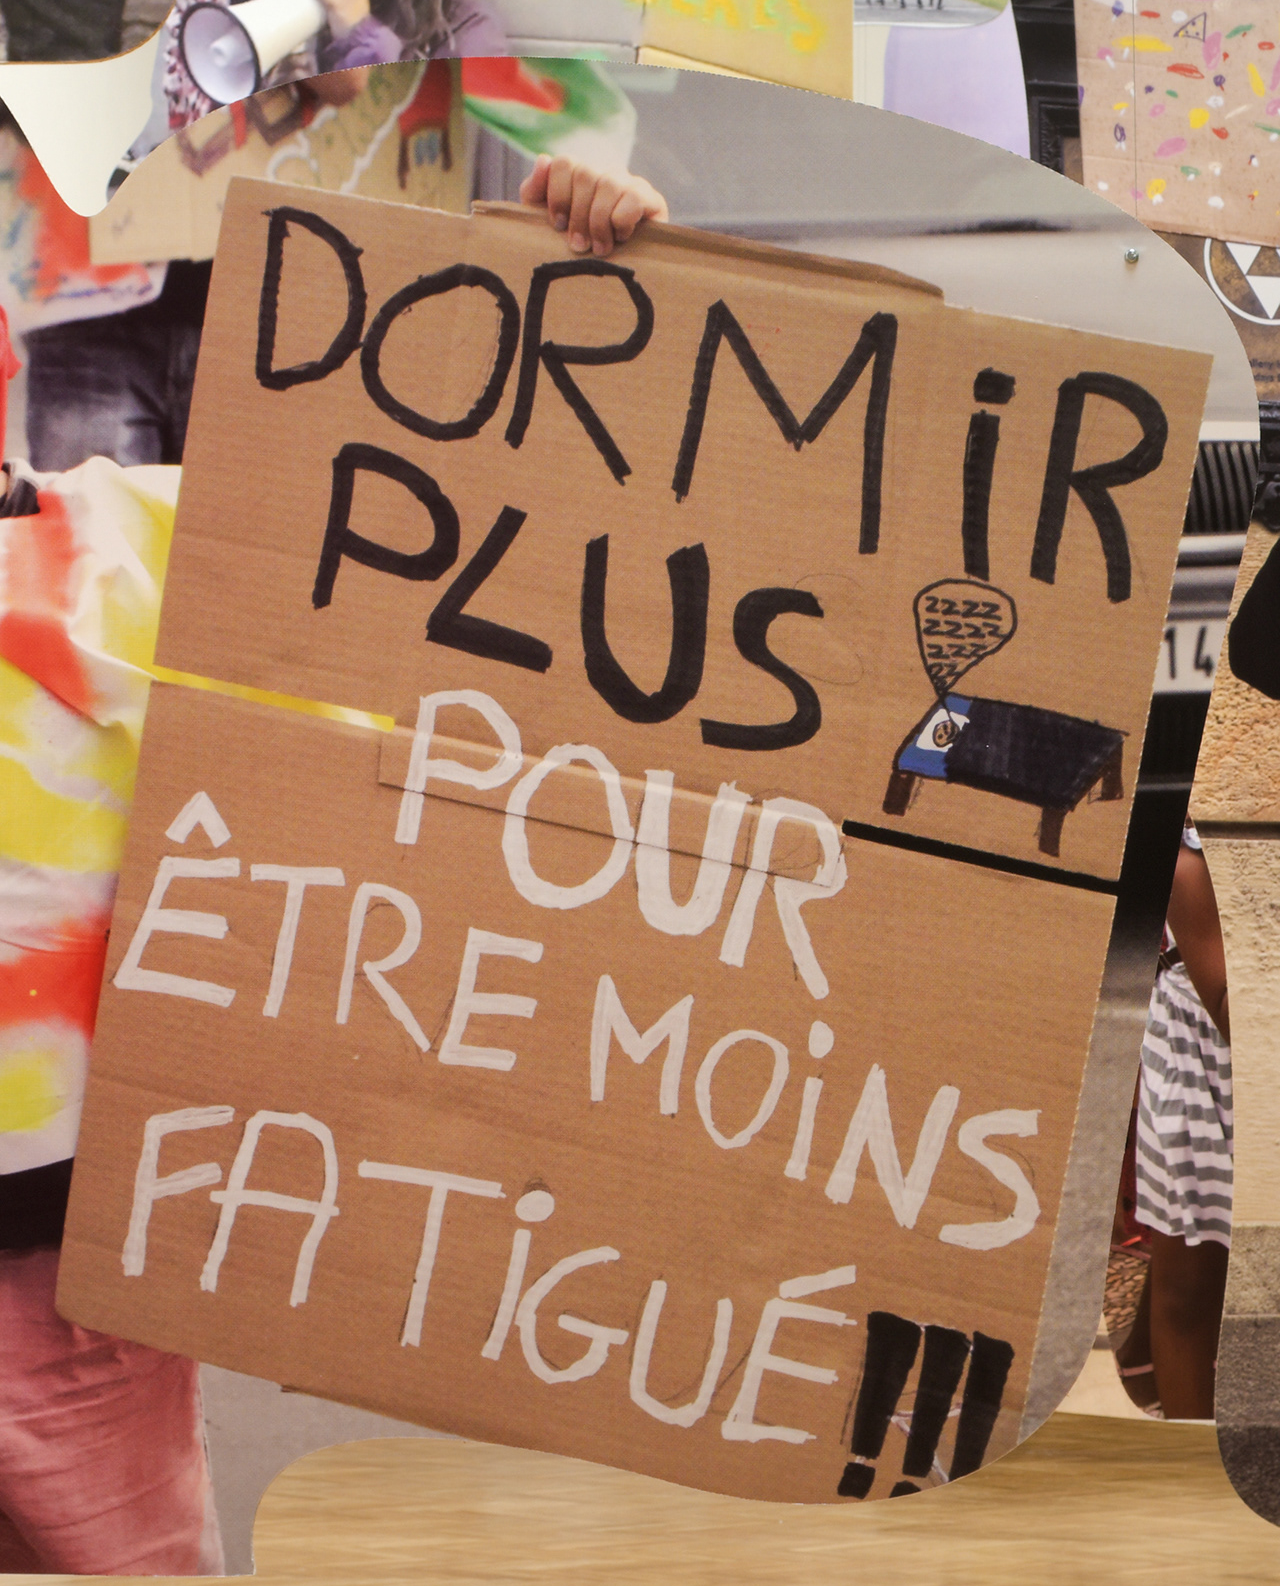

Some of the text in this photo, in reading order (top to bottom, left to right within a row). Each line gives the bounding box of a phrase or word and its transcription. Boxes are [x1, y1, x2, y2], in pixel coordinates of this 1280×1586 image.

[312, 442, 825, 751] PLUS
[113, 790, 544, 1071] ÊTRE
[394, 688, 848, 999] POUR
